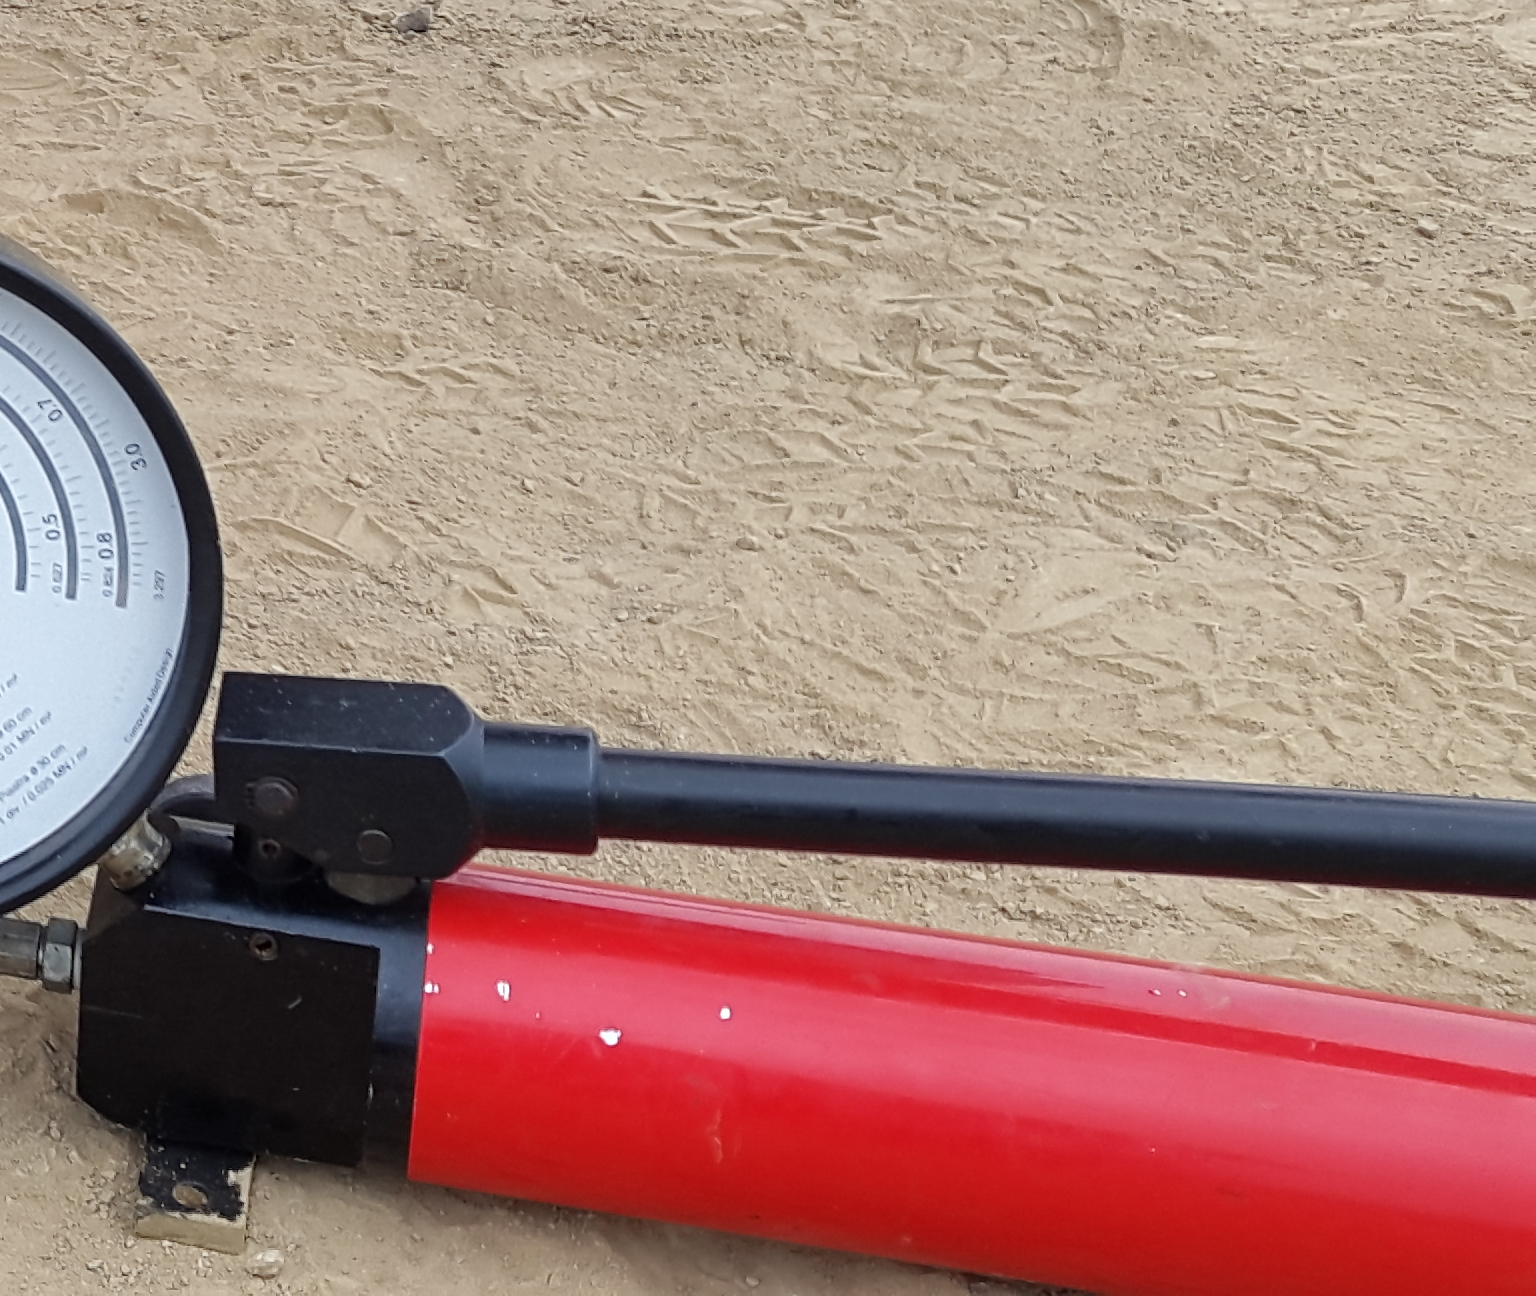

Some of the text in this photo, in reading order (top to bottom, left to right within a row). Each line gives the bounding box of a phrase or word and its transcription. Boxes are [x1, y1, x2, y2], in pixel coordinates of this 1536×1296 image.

[37, 399, 63, 422] 0.7
[124, 443, 147, 471] 3.0
[41, 513, 61, 541] 0.5
[97, 532, 114, 560] 0.8
